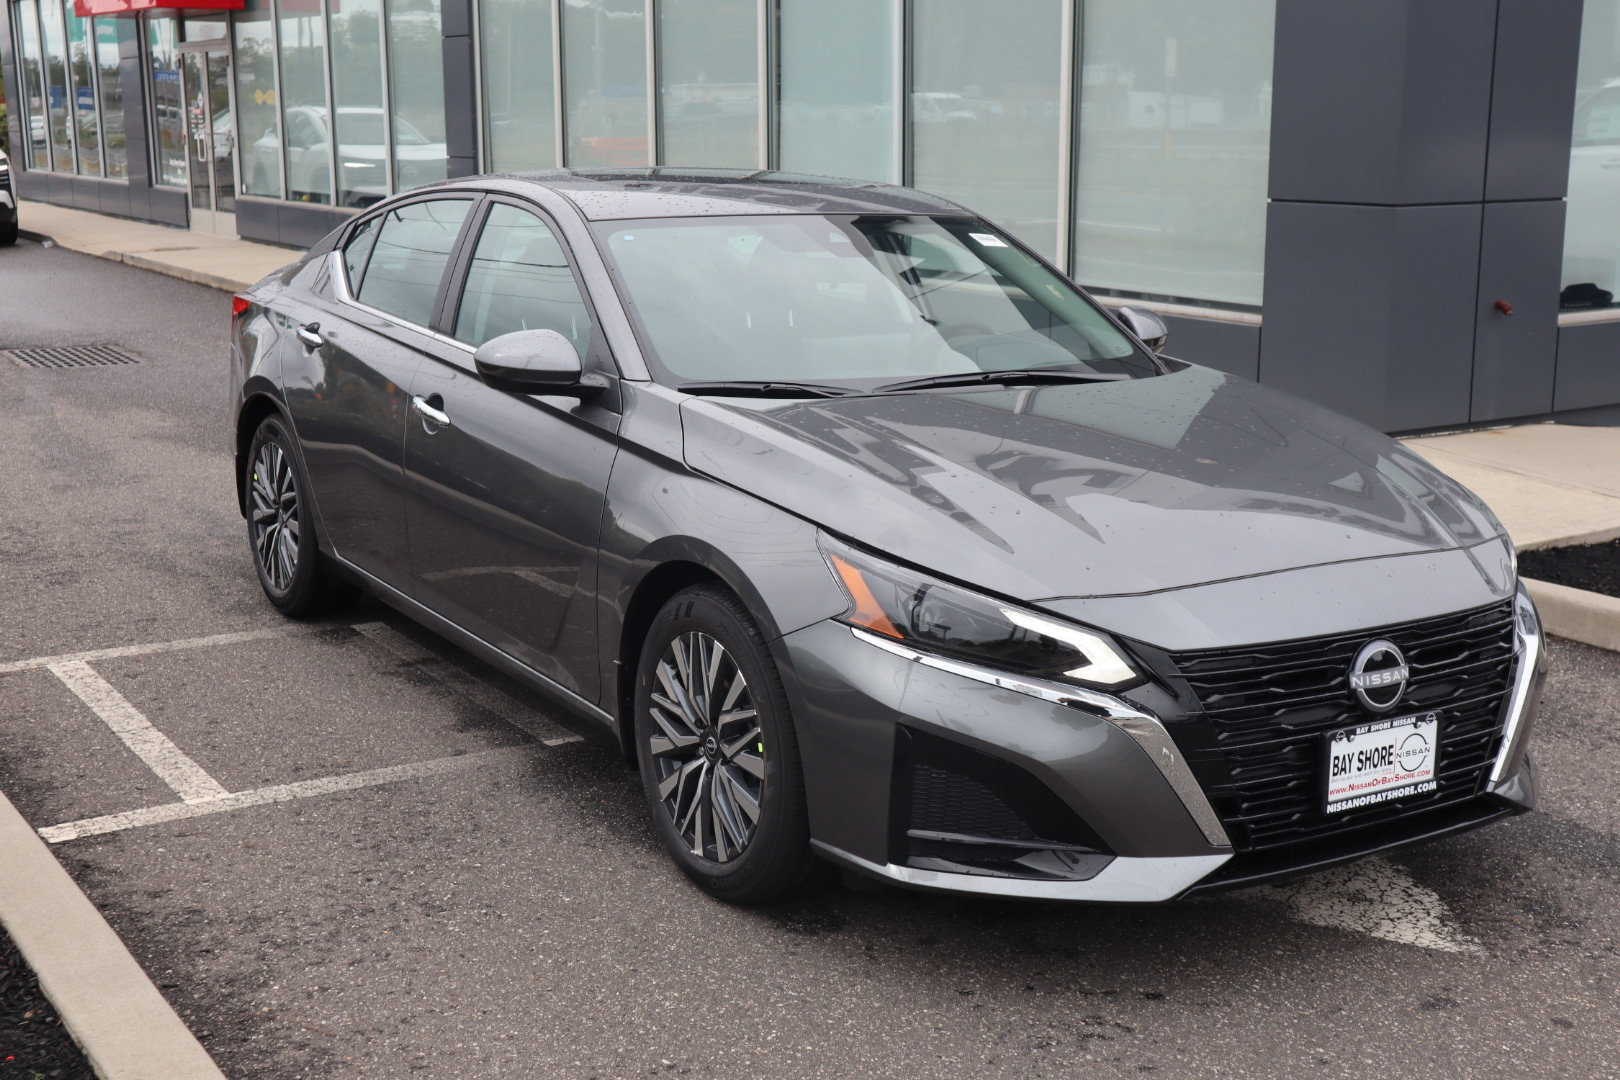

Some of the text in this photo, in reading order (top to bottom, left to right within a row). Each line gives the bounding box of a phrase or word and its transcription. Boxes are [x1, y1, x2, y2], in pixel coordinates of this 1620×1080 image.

[1352, 668, 1408, 687] NISSAN
[1356, 716, 1416, 735] BAY SHORE NISSAN
[1332, 744, 1394, 777] BAY SHORE
[1396, 747, 1431, 758] NISSAN
[1326, 780, 1437, 814] NISSANOFBAYSHORE.COM
